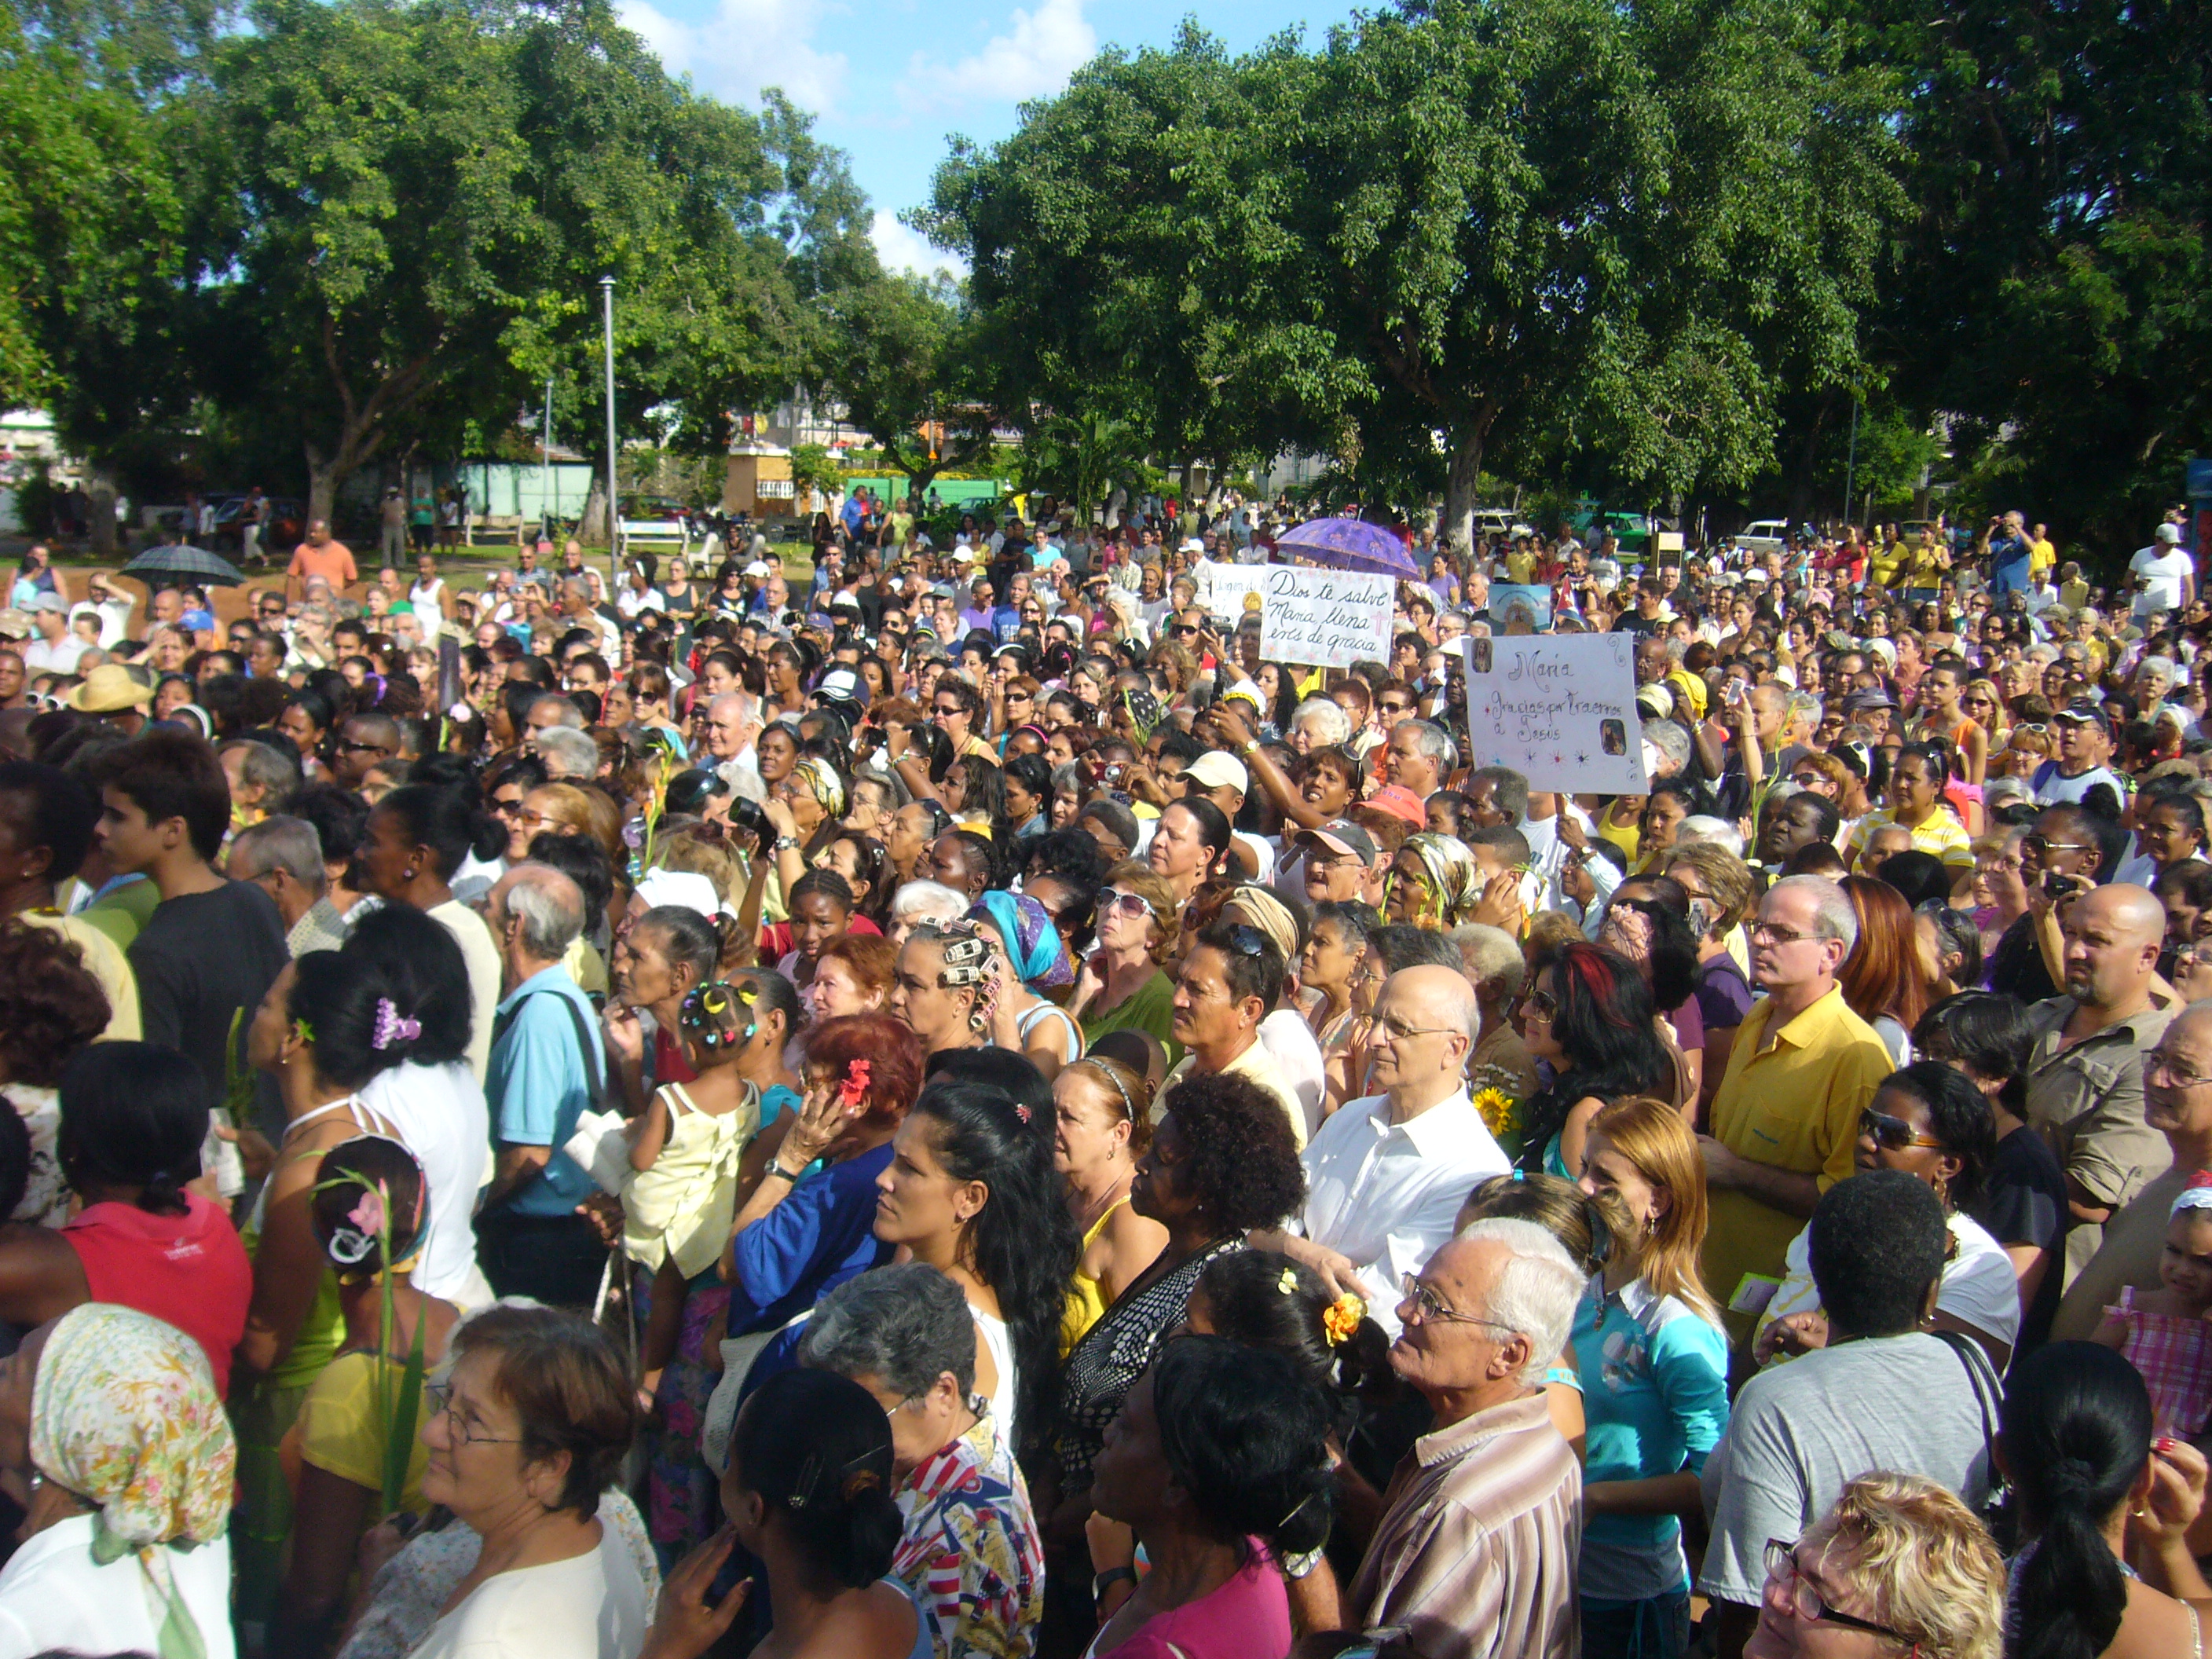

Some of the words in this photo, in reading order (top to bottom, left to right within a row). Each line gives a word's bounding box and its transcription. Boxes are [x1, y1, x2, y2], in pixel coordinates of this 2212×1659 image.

[1269, 569, 1310, 598] Dios
[1313, 582, 1334, 599] te
[1338, 584, 1388, 606] salve
[1322, 606, 1371, 630] llena
[1267, 628, 1302, 642] eres
[1307, 625, 1323, 644] de
[1545, 701, 1566, 724] por
[1494, 723, 1505, 734] a
